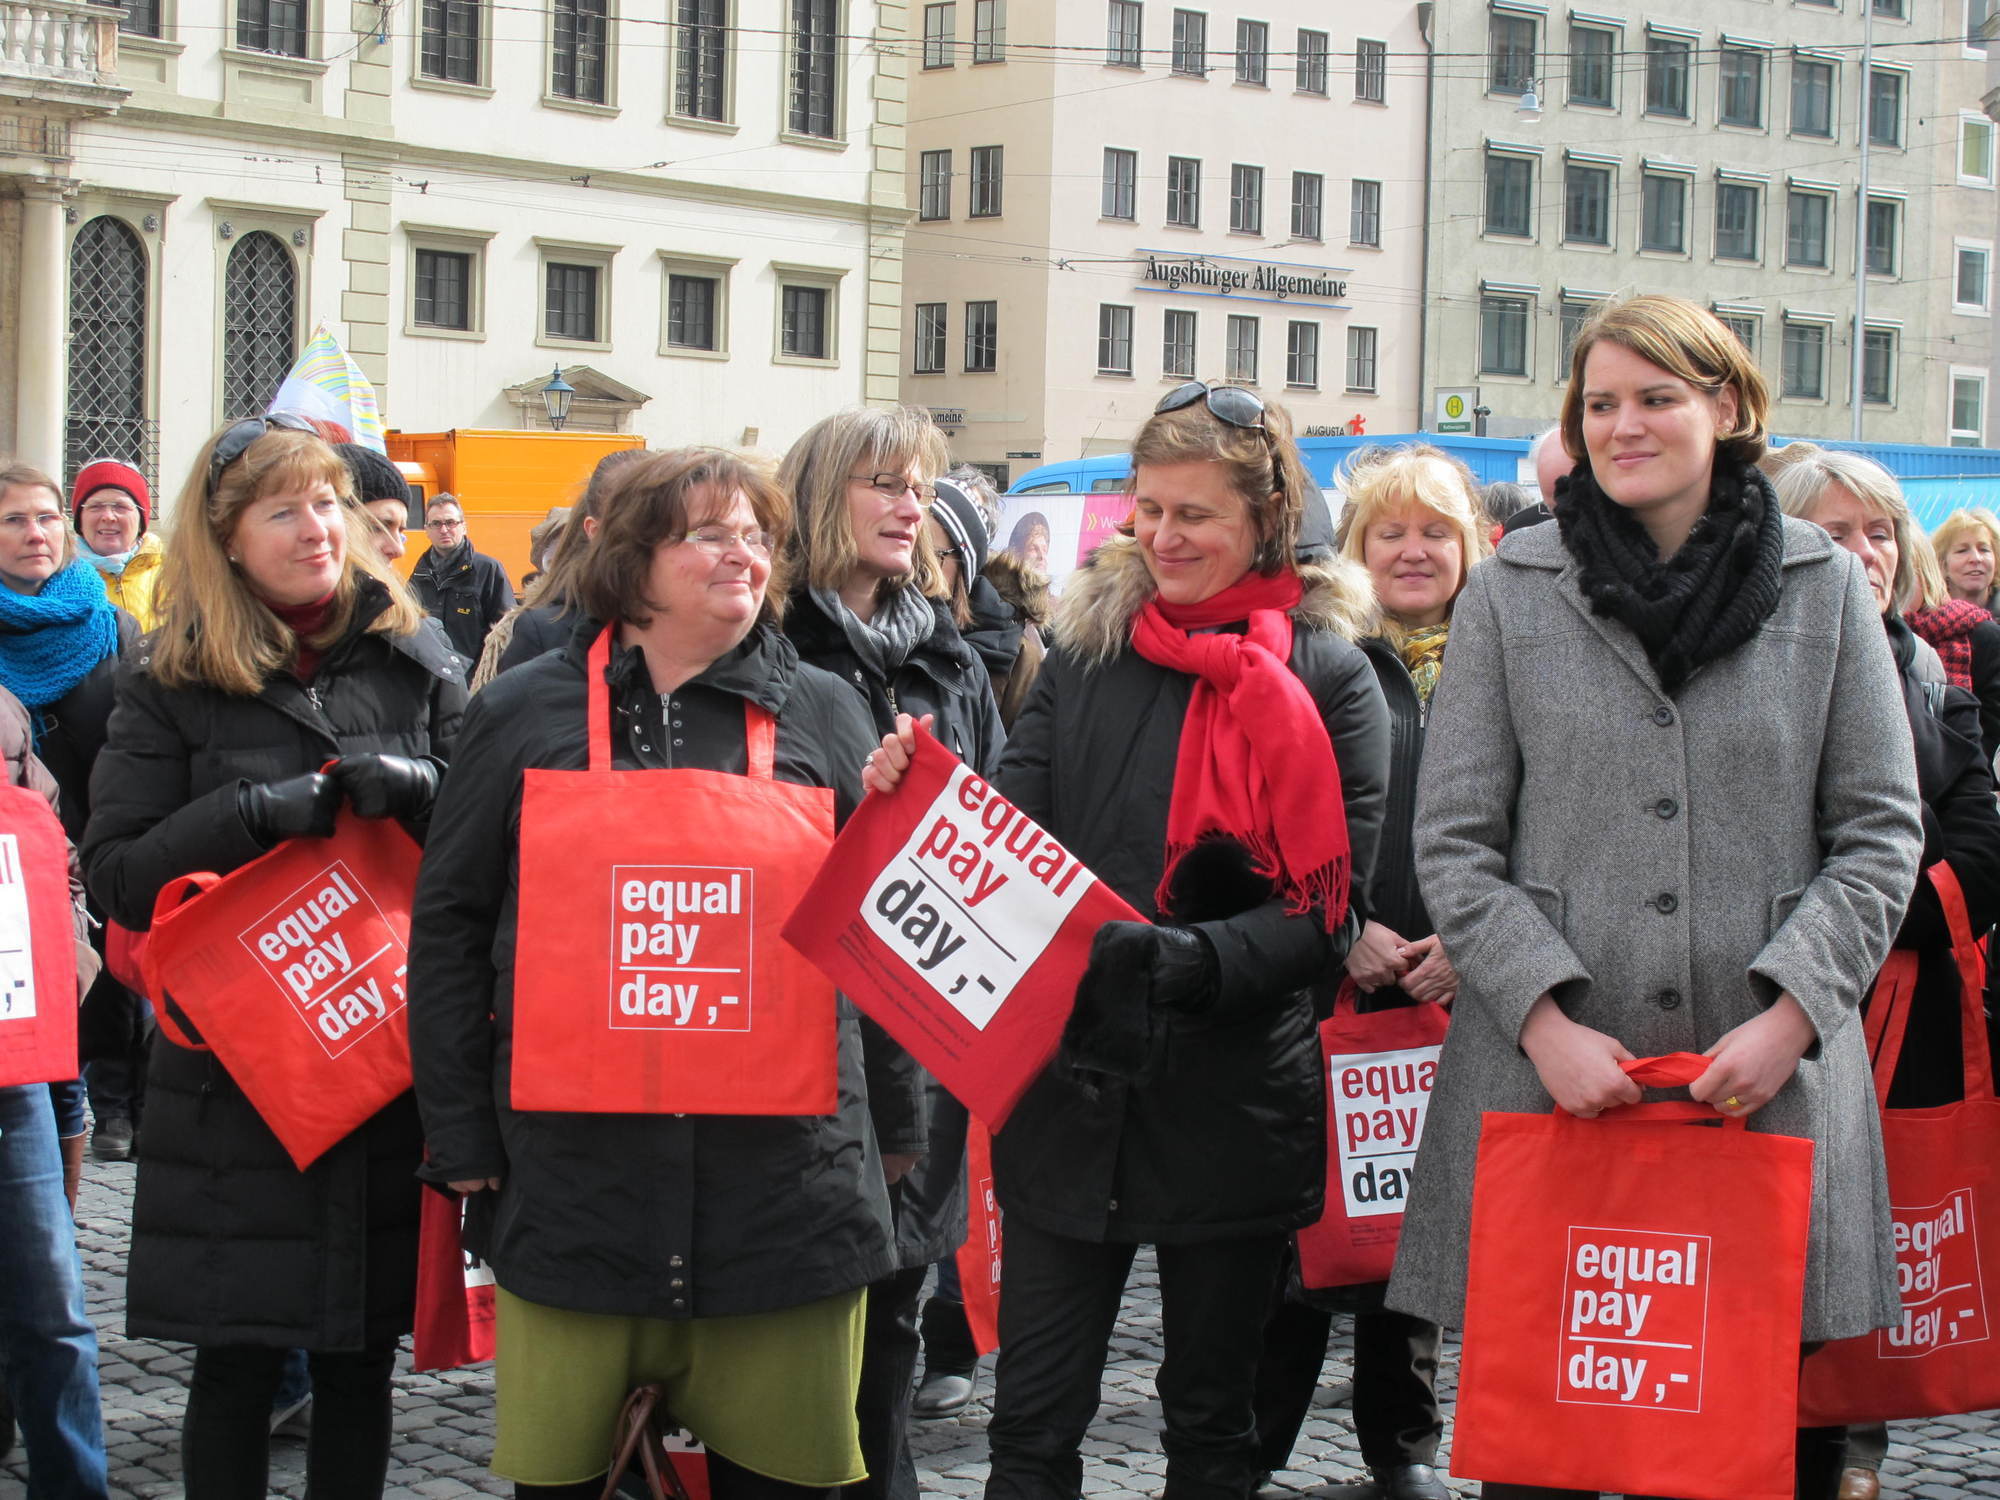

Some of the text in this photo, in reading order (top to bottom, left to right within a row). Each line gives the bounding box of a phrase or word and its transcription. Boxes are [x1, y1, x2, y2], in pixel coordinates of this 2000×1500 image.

[1144, 256, 1347, 299] Augsburger Allgemeine
[1305, 425, 1345, 437] AUGUSTA
[958, 774, 1084, 897] equal
[916, 815, 1009, 908] pay
[258, 871, 359, 962] equal
[621, 874, 741, 921] equal
[621, 922, 700, 965] pay
[875, 878, 967, 971] day
[282, 931, 352, 1003] pay
[318, 977, 385, 1041] day
[619, 974, 699, 1025] day
[1341, 1060, 1438, 1105] equa
[1345, 1107, 1418, 1152] pay
[1352, 1161, 1414, 1203] da
[1892, 1196, 1964, 1258] equal
[1575, 1242, 1698, 1289] equal
[1570, 1290, 1652, 1337] pay
[1568, 1344, 1648, 1401] day
